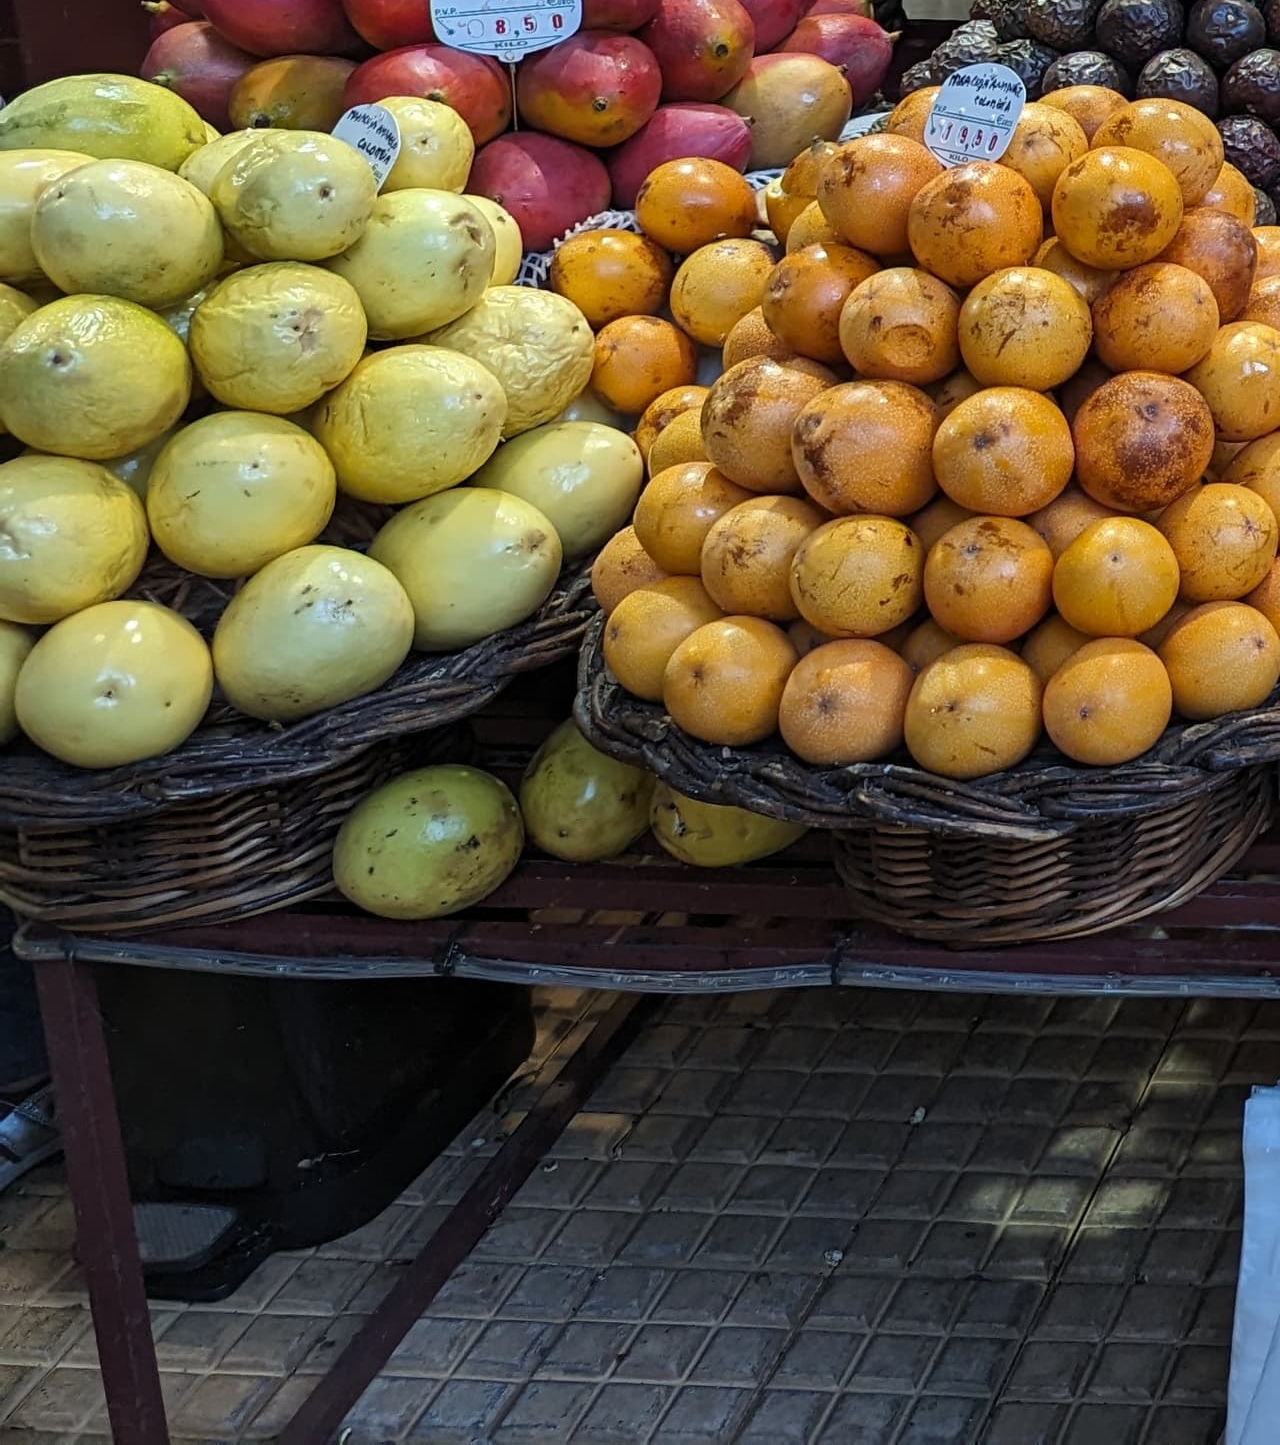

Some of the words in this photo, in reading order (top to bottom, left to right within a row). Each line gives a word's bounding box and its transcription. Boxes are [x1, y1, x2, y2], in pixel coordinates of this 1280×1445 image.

[434, 7, 458, 16] P.V.P.
[495, 14, 563, 38] 8,50
[494, 40, 529, 48] KILO
